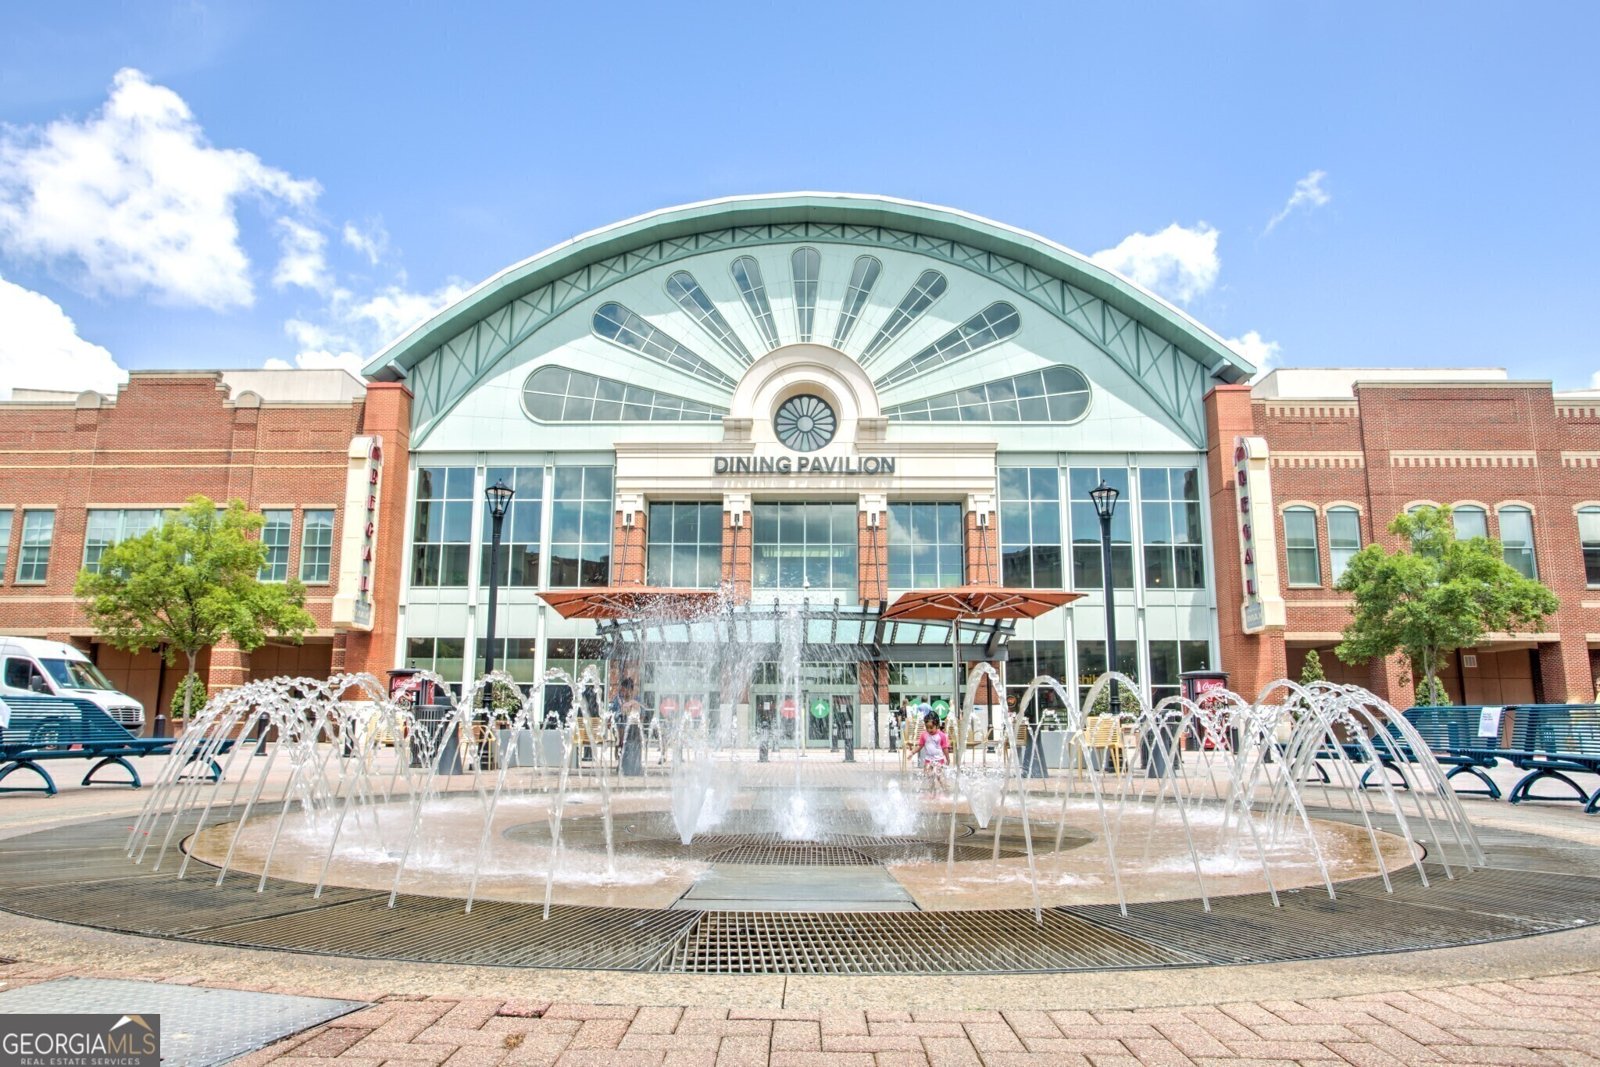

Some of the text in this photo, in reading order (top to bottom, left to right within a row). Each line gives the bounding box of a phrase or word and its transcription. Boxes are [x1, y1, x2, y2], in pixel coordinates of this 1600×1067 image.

[714, 456, 896, 475] DINING PAVILION
[361, 469, 378, 592] REGAL
[1238, 470, 1256, 595] REGAL
